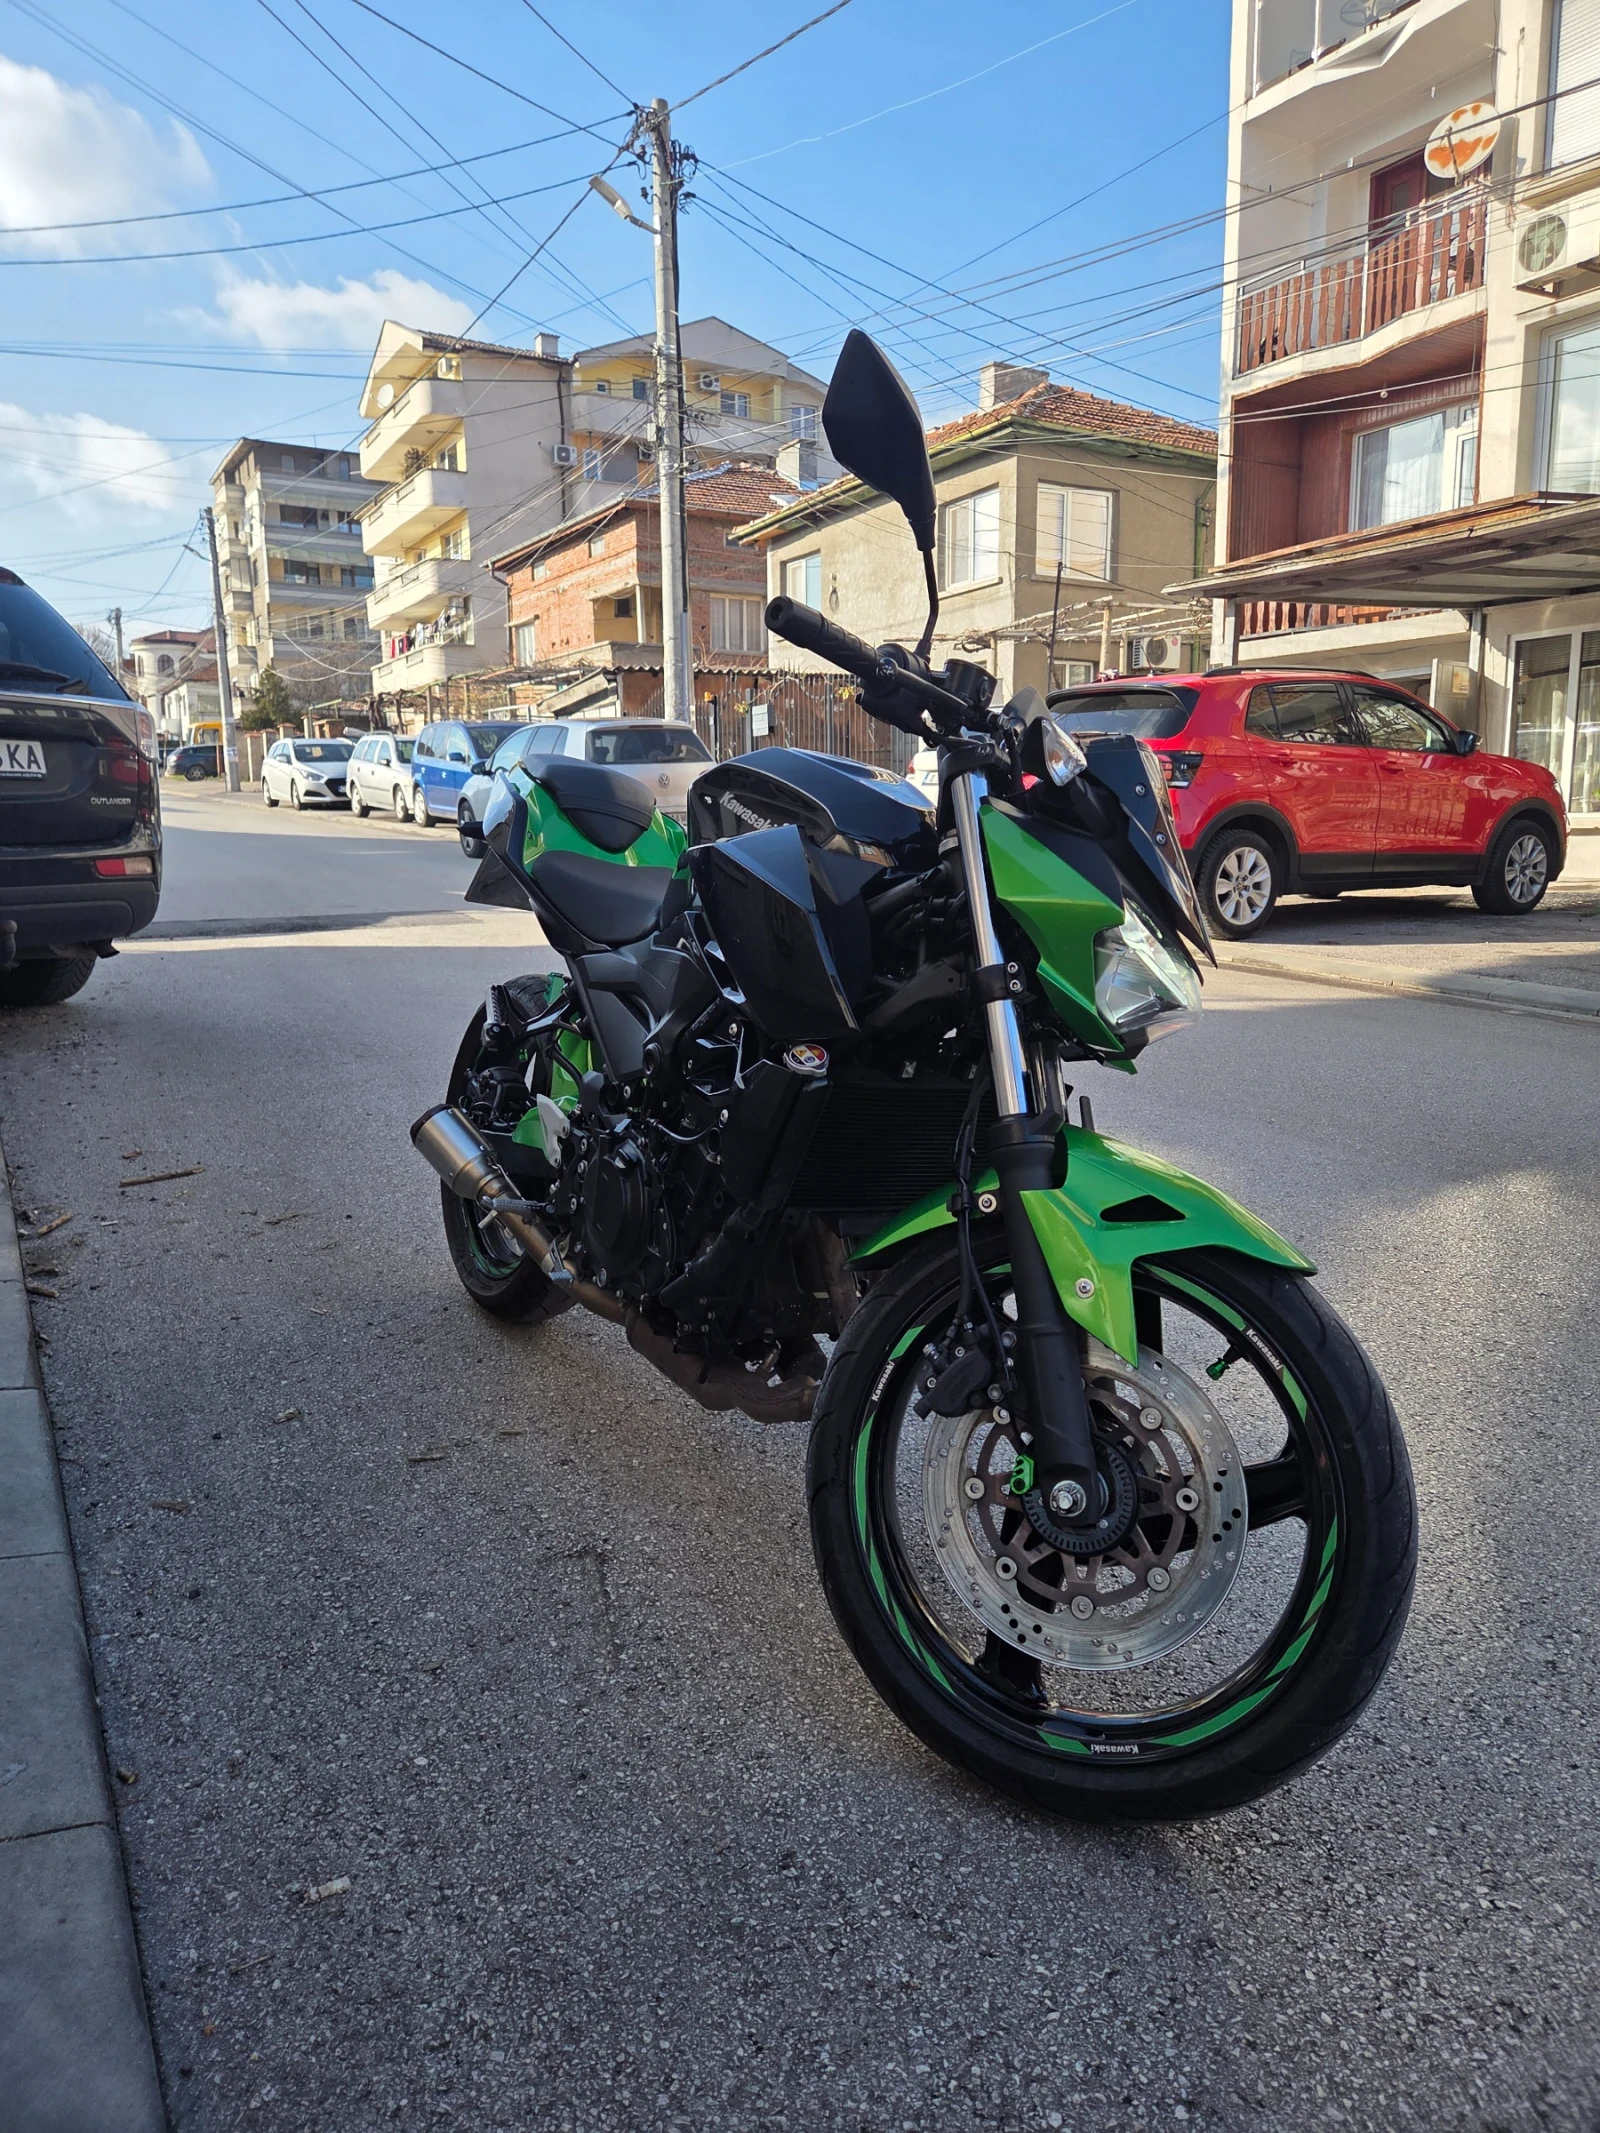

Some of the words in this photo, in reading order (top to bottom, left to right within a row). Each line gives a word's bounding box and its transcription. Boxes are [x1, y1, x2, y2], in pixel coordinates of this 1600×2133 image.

[90, 796, 131, 805] OUTLANDER
[719, 791, 778, 830] Kawasak
[1245, 1328, 1283, 1370] Kawasaki
[871, 1360, 895, 1401] Kawasaki
[1090, 1743, 1139, 1754] Kawasaki
